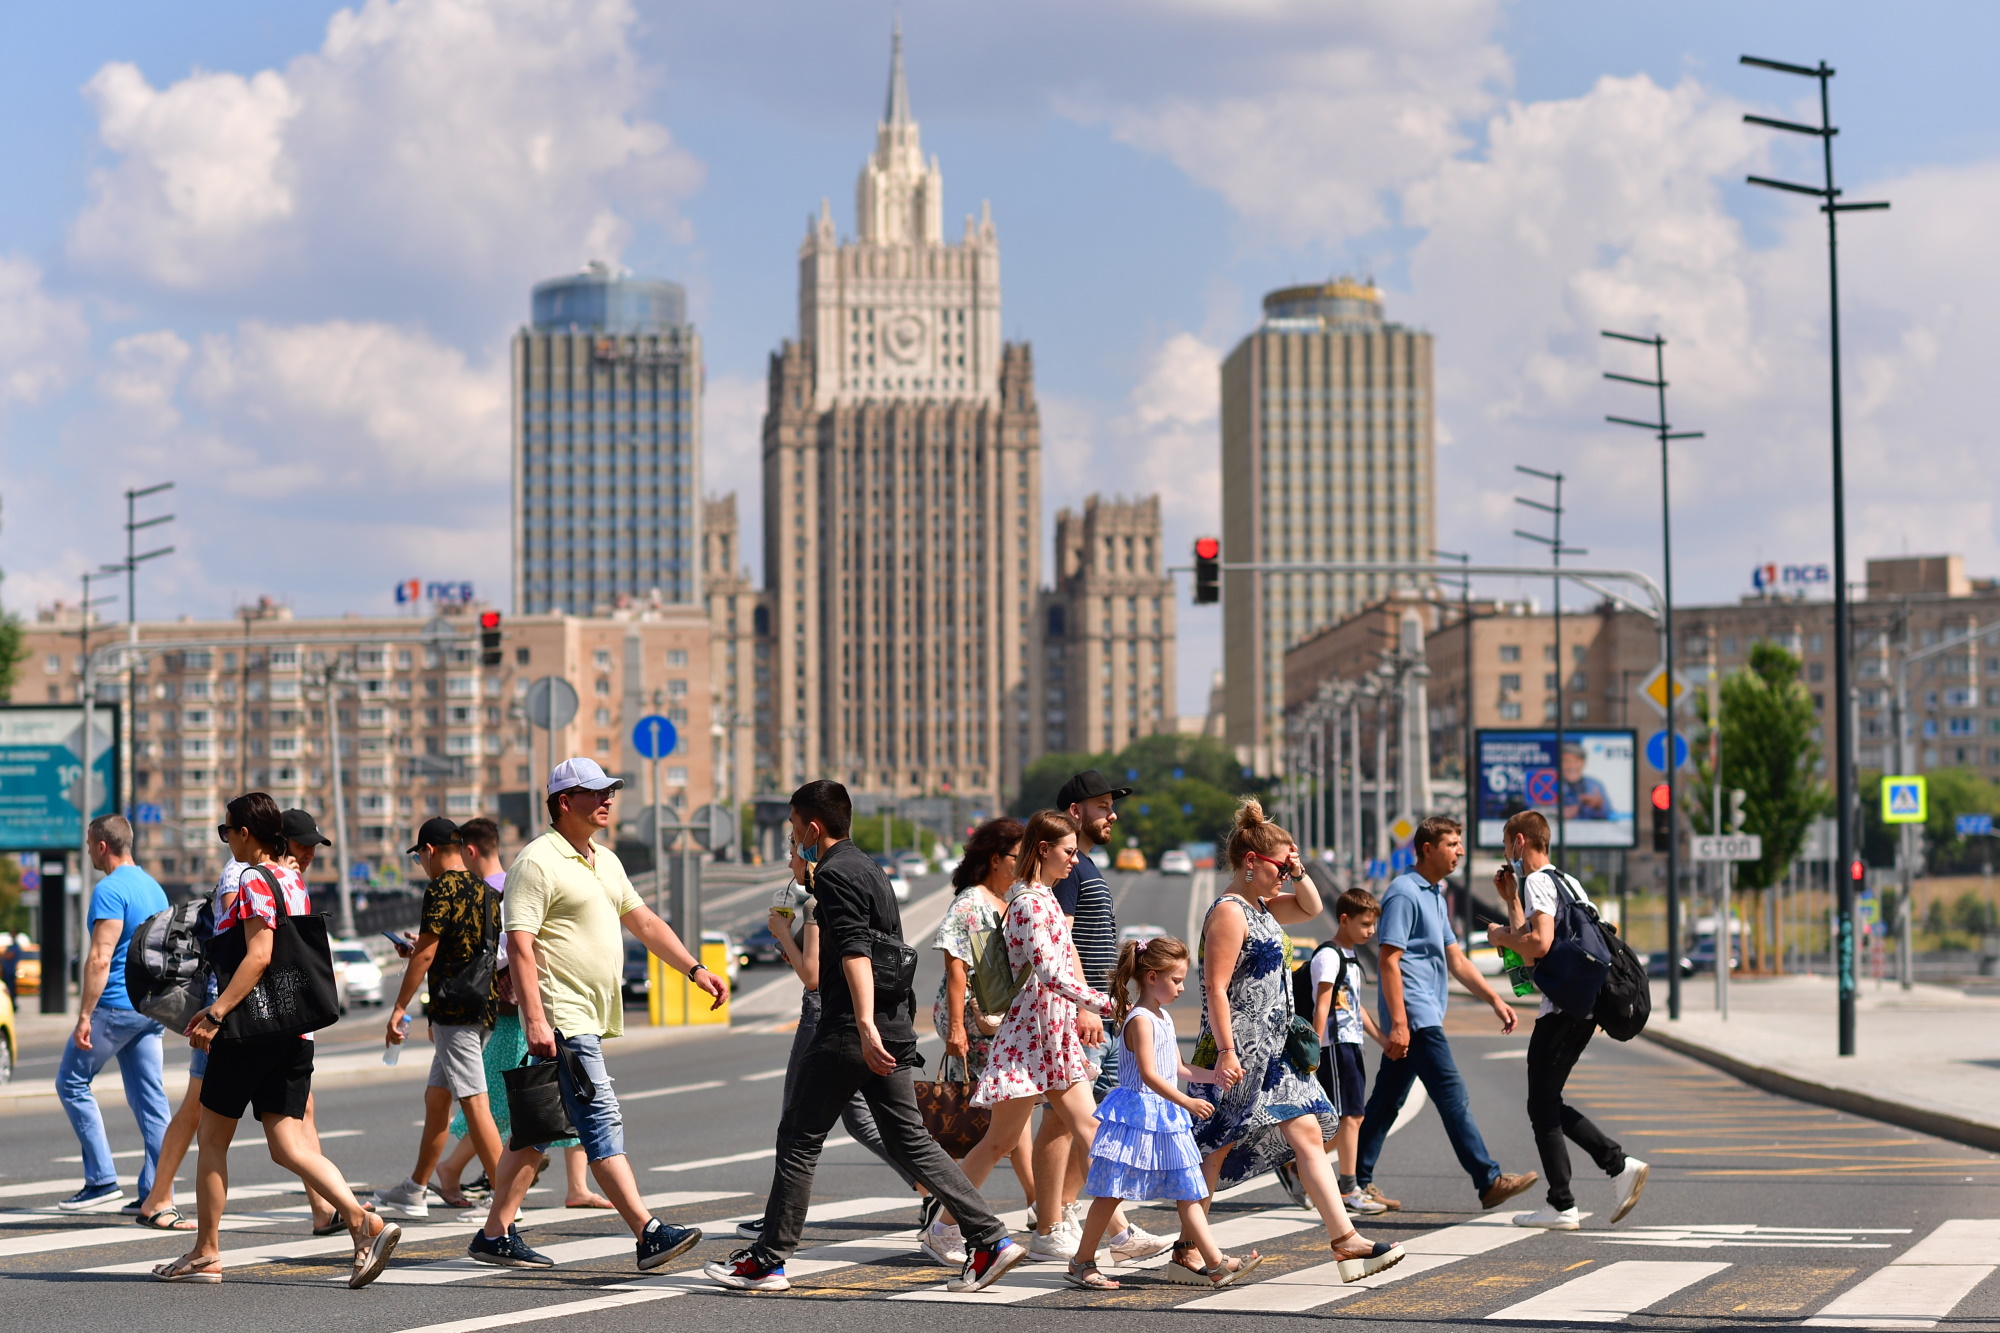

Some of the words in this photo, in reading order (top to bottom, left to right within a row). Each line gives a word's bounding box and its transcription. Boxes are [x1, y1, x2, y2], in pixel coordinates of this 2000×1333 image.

[1783, 565, 1829, 582] ПСБ
[427, 581, 474, 600] ПСБ
[1700, 840, 1751, 856] СТОП
[256, 996, 293, 1016] PEPE
